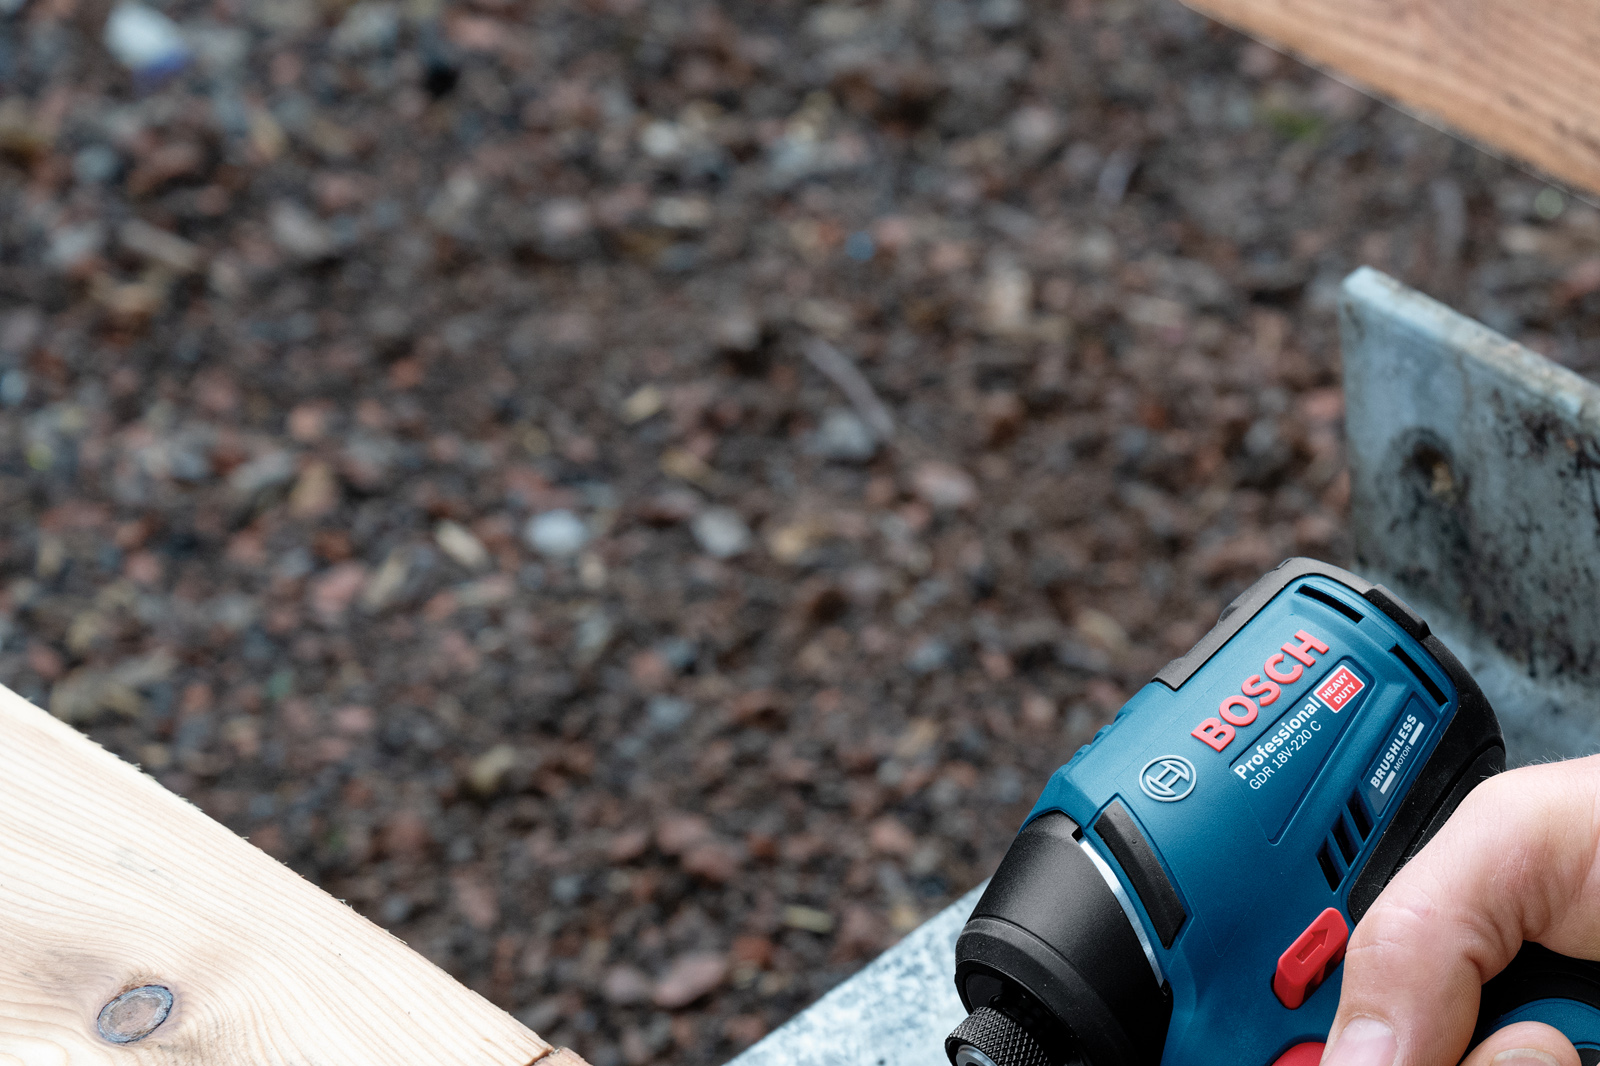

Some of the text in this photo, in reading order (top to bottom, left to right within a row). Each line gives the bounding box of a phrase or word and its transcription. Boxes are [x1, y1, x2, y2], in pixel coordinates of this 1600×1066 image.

[1191, 629, 1330, 752] BOSCH
[1321, 672, 1349, 699] HEAVY
[1333, 681, 1356, 705] DUTY
[1233, 696, 1322, 780] Professional
[1249, 720, 1322, 790] GDR 18V-220 C
[1370, 714, 1417, 788] BRUSHLESS
[1393, 745, 1412, 771] MOTOR
